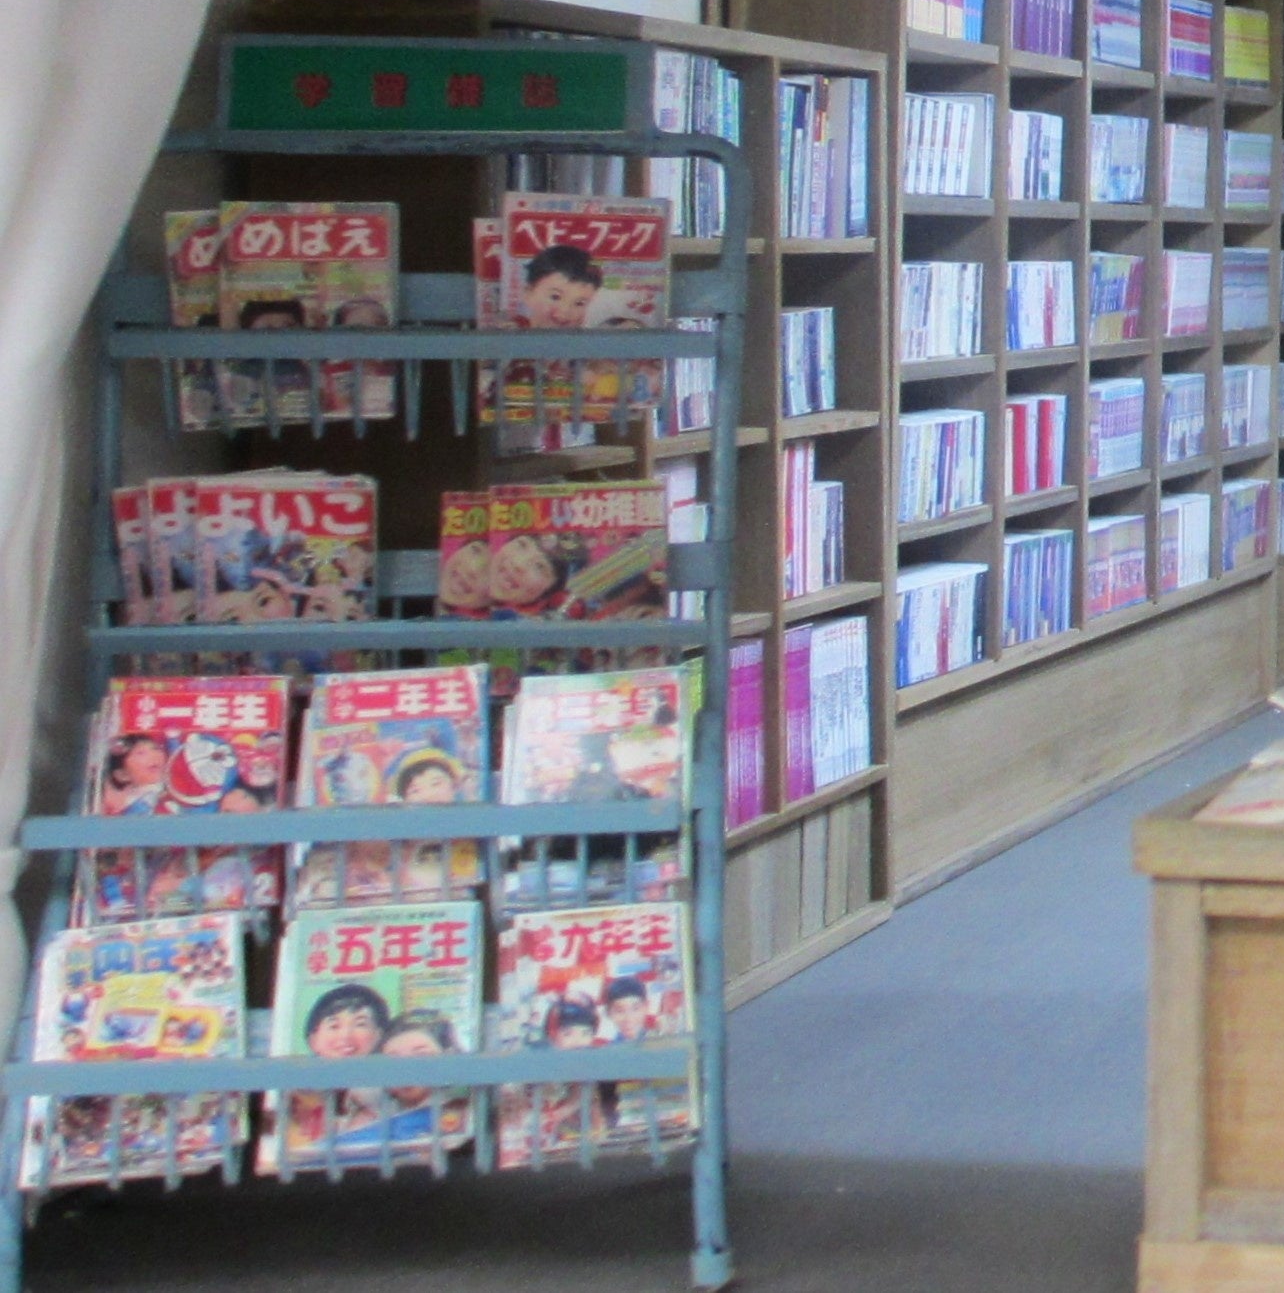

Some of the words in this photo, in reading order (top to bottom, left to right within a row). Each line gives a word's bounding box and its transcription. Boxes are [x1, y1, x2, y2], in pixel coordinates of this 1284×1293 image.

[239, 218, 380, 257] めばえ
[197, 492, 369, 553] よいこ
